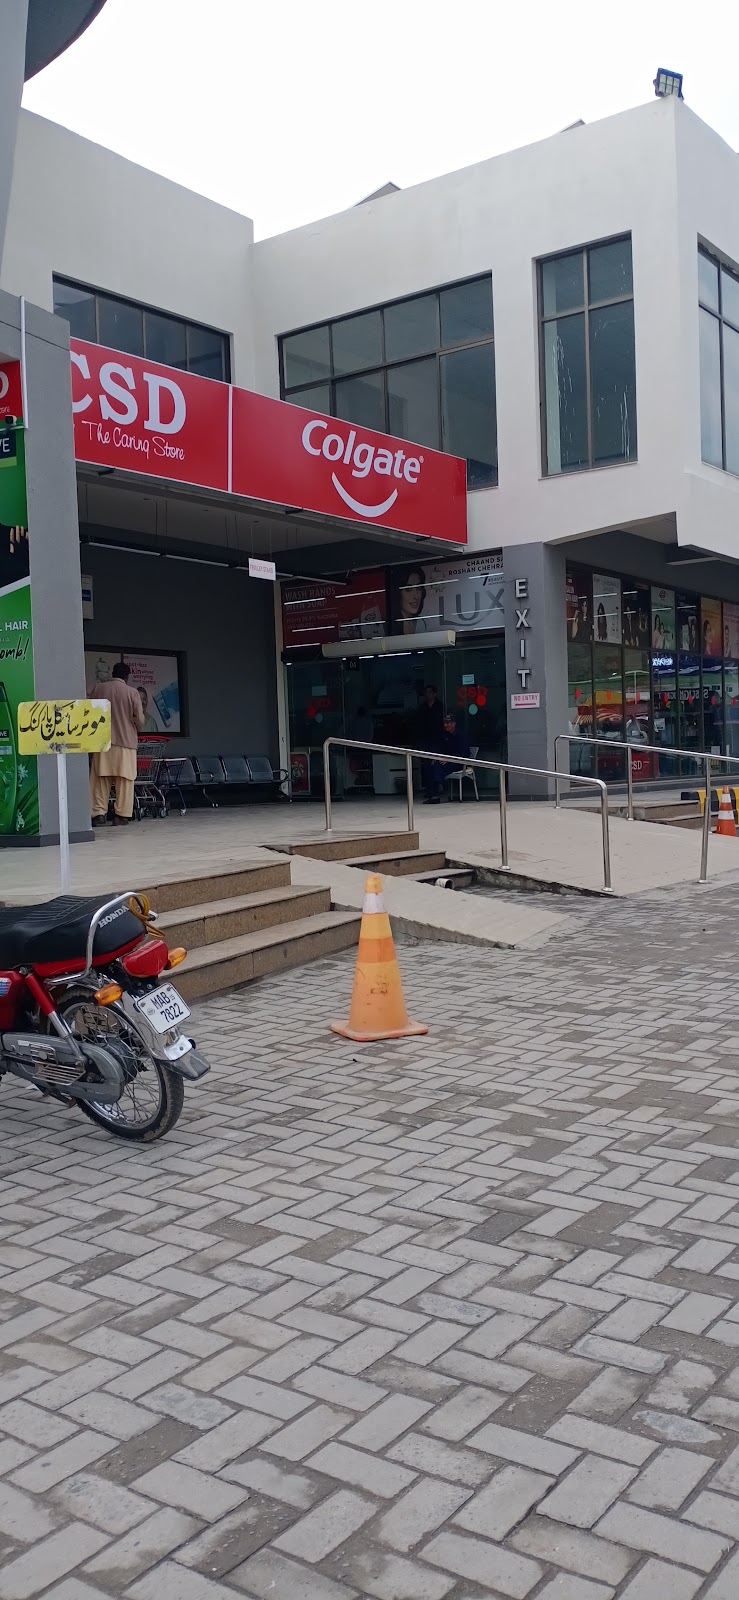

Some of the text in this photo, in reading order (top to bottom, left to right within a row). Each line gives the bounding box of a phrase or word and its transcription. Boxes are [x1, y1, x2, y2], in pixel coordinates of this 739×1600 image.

[82, 421, 184, 460] The Caring Store
[302, 420, 420, 483] Colgate
[448, 566, 476, 576] ROSHAN
[467, 557, 494, 567] CHAAND
[285, 586, 336, 601] WASH HANDS
[438, 588, 505, 627] LUX
[5, 620, 28, 631] HAIR
[515, 579, 530, 688] EXIT
[631, 760, 643, 770] SD
[97, 904, 130, 928] HONDA
[150, 991, 171, 1010] MAB
[160, 1003, 184, 1023] 7822
